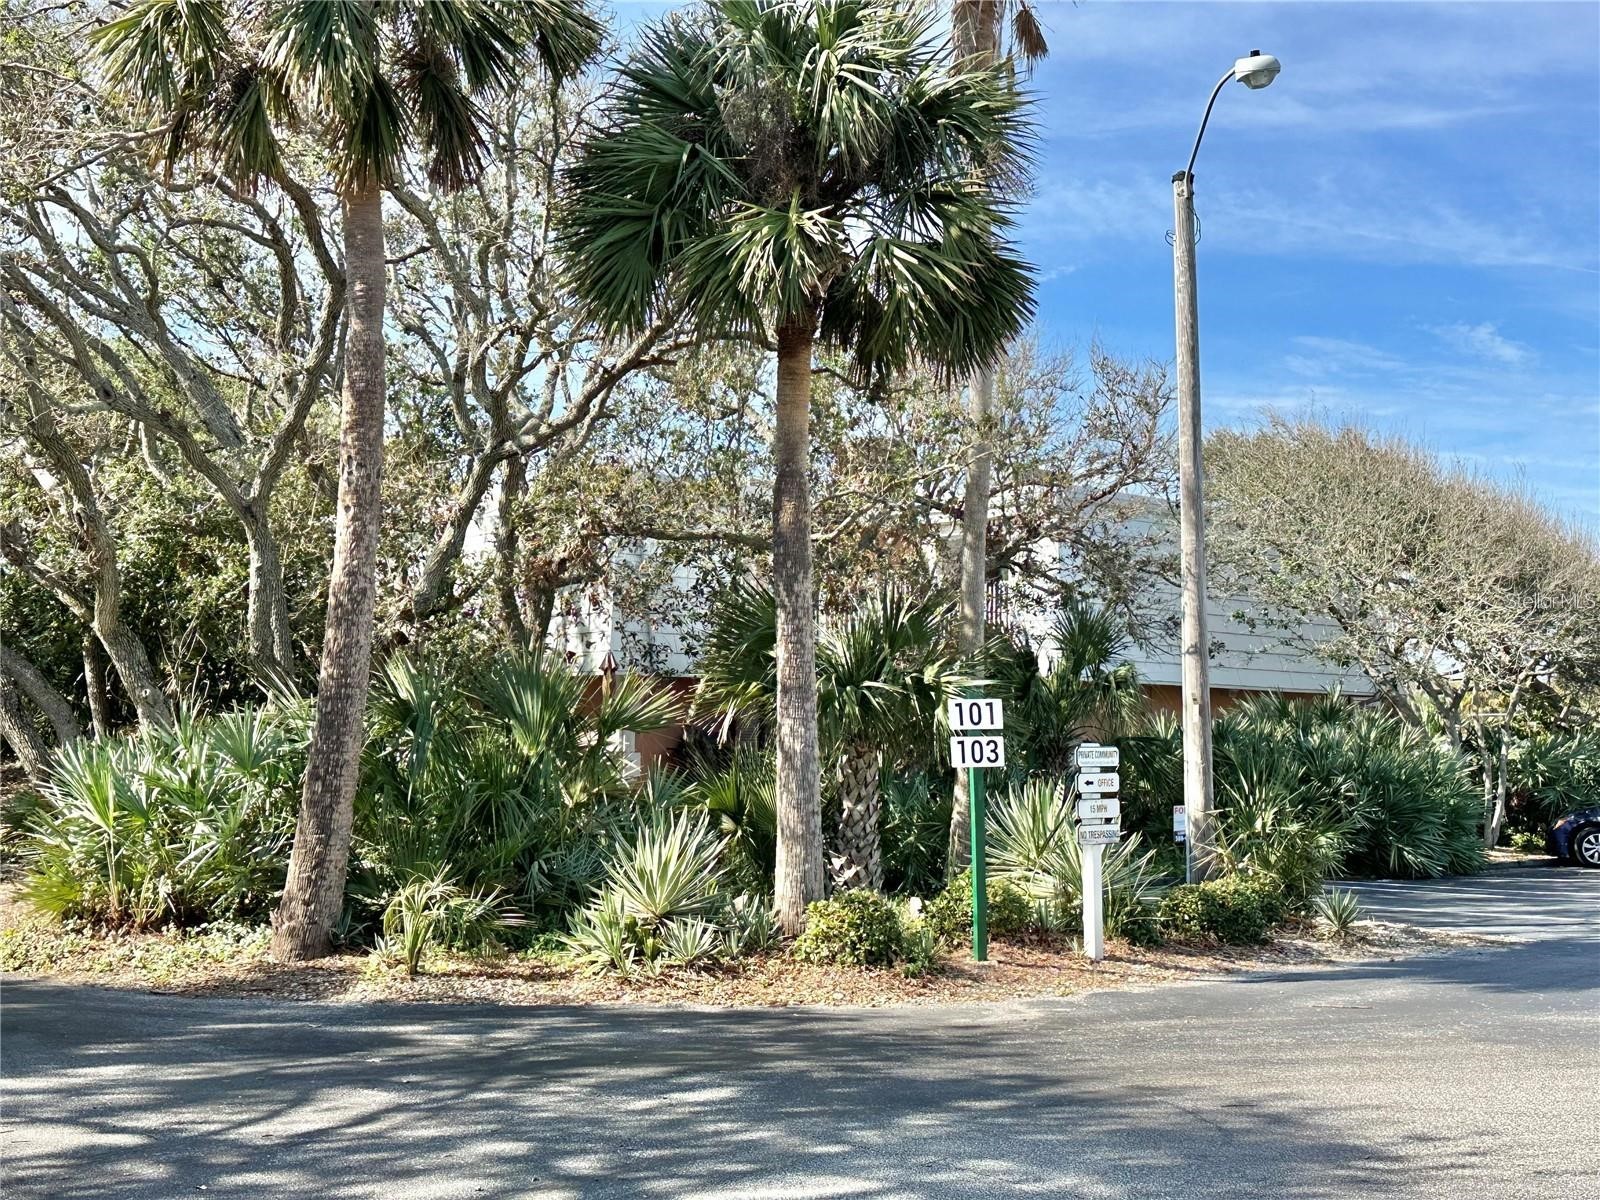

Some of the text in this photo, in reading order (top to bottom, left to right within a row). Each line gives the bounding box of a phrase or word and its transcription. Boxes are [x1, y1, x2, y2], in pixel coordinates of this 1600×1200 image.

[954, 701, 995, 726] 101
[957, 739, 999, 764] 103
[1078, 750, 1118, 759] PRIVATE COMMUNITY
[1098, 778, 1114, 787] OFFICE
[1090, 804, 1108, 813] 15 MPH
[1080, 830, 1088, 839] NO
